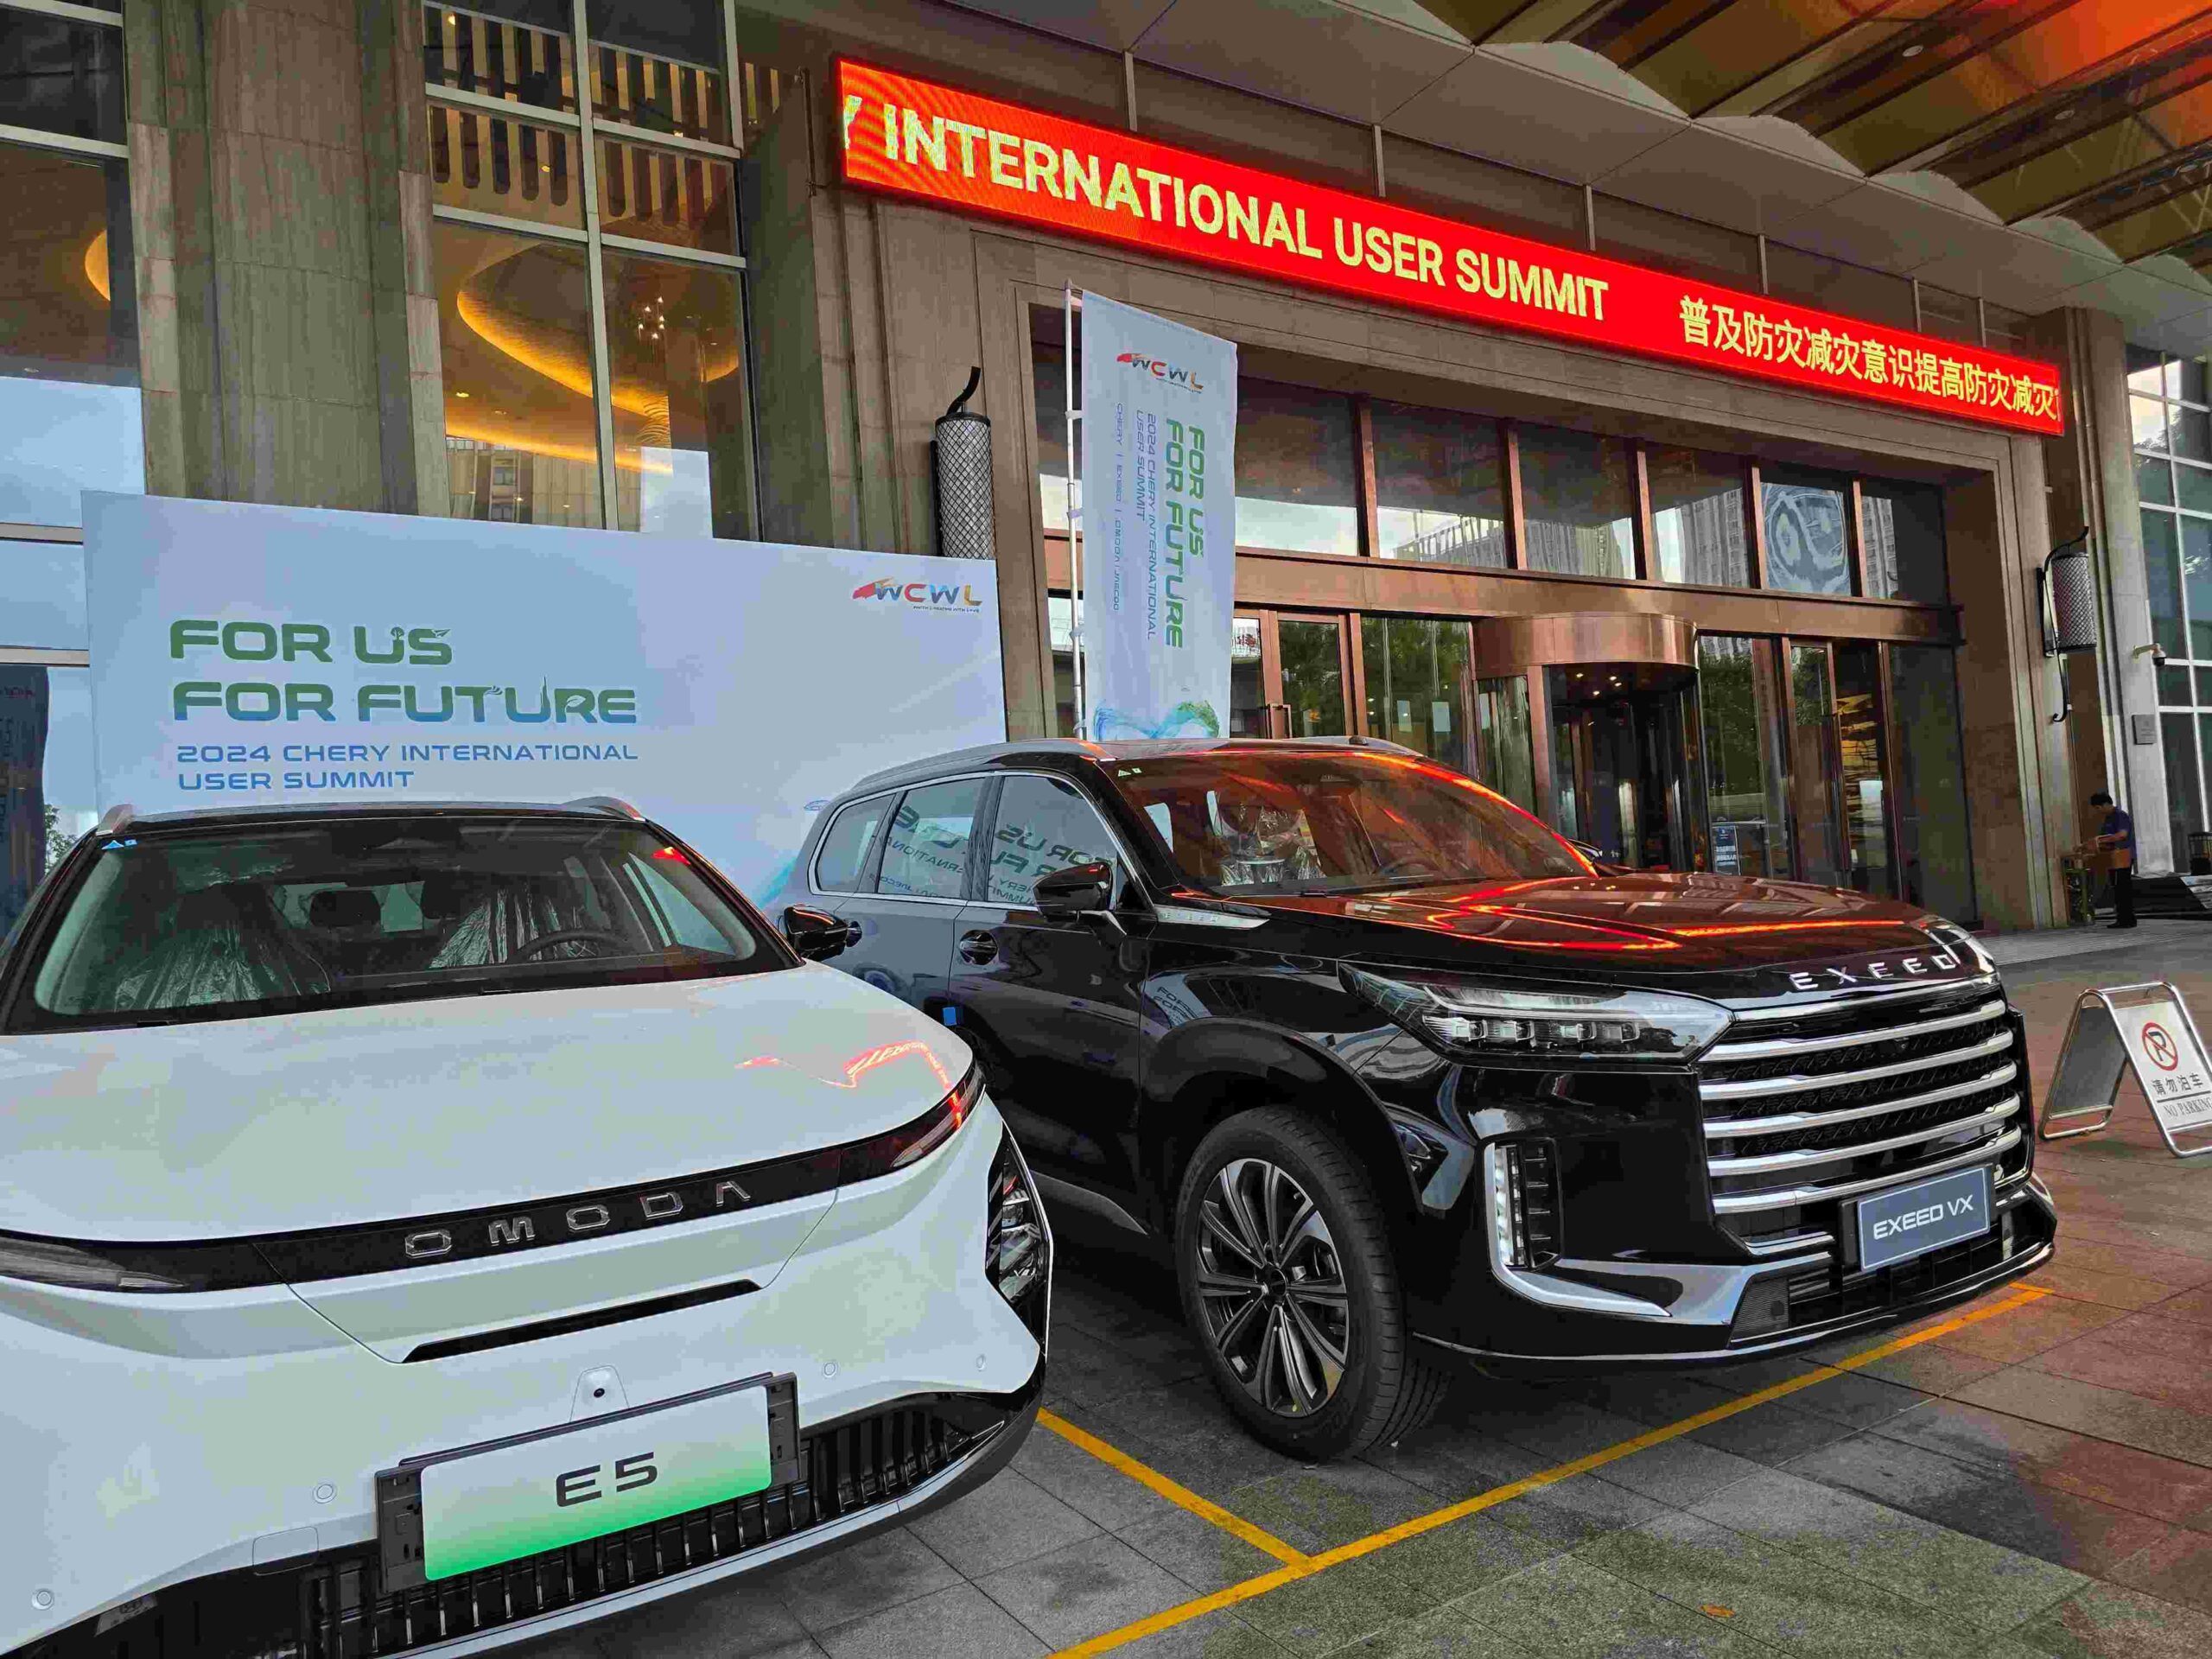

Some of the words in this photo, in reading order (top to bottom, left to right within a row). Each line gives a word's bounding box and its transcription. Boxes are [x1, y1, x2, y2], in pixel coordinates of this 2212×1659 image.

[884, 104, 1322, 260] INTERNATIONAL
[1333, 218, 1446, 286] USER
[1456, 249, 1610, 321] SUMMIT
[1679, 295, 2061, 422] 普及防灾减灾意识提高防灾减灾
[1136, 410, 1145, 455] USER
[1147, 413, 1156, 455] 2024
[1166, 417, 1184, 493] FOR
[1136, 456, 1146, 521] SUMMIT
[1147, 457, 1156, 512] CHERY
[1189, 426, 1205, 499] FOR
[1189, 508, 1204, 557] US
[1147, 513, 1157, 640] INTERNATIONAL
[1166, 500, 1186, 649] FUTURE
[170, 620, 334, 662] FOR
[353, 626, 453, 665] US
[173, 681, 336, 721] FOR
[357, 675, 637, 724] FUTURE
[177, 745, 271, 762] 2024
[283, 744, 391, 762] CHERY
[402, 744, 639, 761] INTERNATIONAL
[178, 772, 272, 790] USER
[284, 771, 415, 789] SUMMIT
[1789, 953, 1959, 990] EXEED
[2164, 1104, 2177, 1117] NO
[405, 1180, 750, 1258] OMODA
[1873, 1204, 1943, 1240] EXEED
[1948, 1194, 1974, 1217] VX
[556, 1452, 658, 1508] E5
